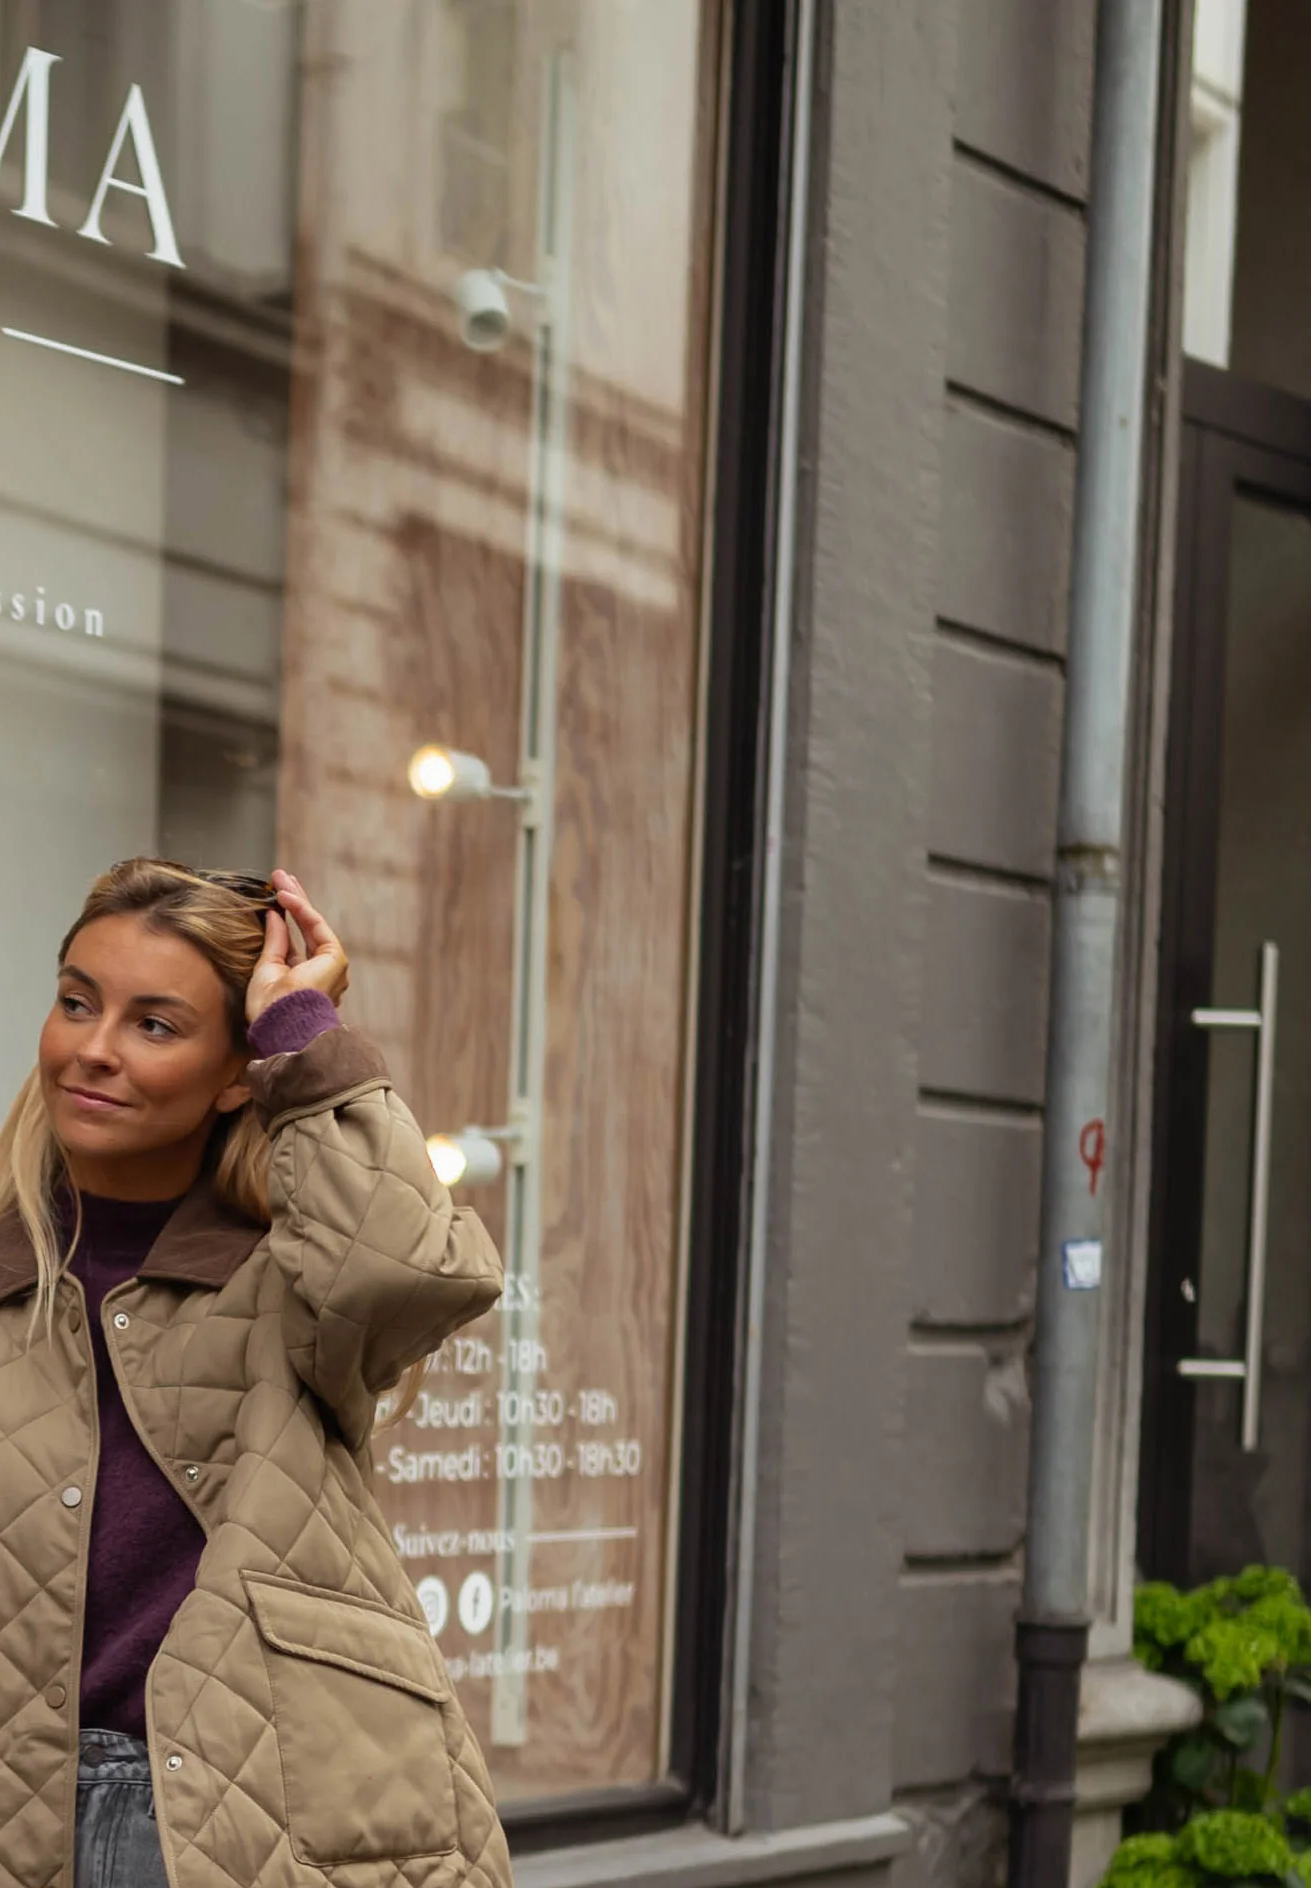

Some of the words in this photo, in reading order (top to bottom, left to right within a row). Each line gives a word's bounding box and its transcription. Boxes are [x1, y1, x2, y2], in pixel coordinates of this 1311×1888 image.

[453, 1338, 492, 1374] 12h
[509, 1338, 549, 1373] 18h
[496, 1390, 565, 1427] 10h30
[578, 1388, 617, 1426] 18h
[494, 1443, 564, 1479] 10h30
[576, 1440, 642, 1477] 18h30
